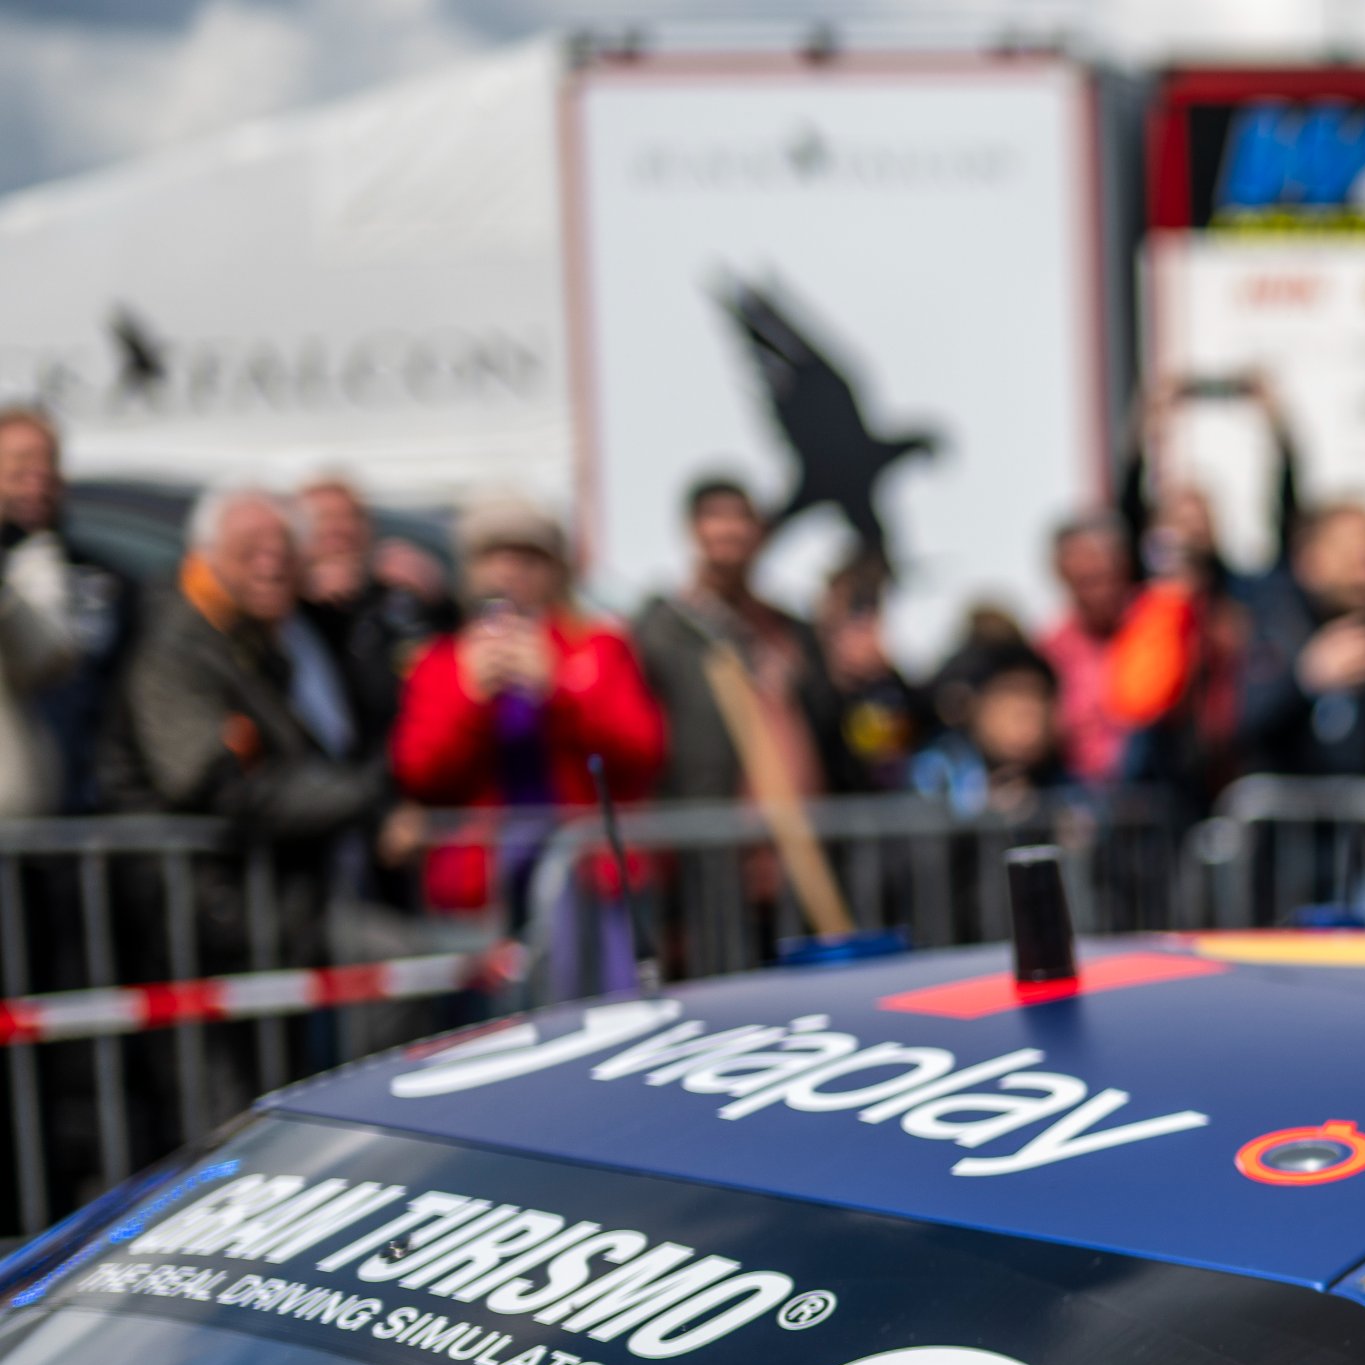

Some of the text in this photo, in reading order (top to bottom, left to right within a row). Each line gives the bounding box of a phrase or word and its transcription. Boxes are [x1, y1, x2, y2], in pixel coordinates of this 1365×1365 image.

[588, 1012, 1210, 1177] viaplay
[128, 1172, 407, 1265] GRAN
[76, 1262, 152, 1293] THE
[140, 1265, 228, 1302] REAL
[216, 1274, 384, 1332] DRIVING
